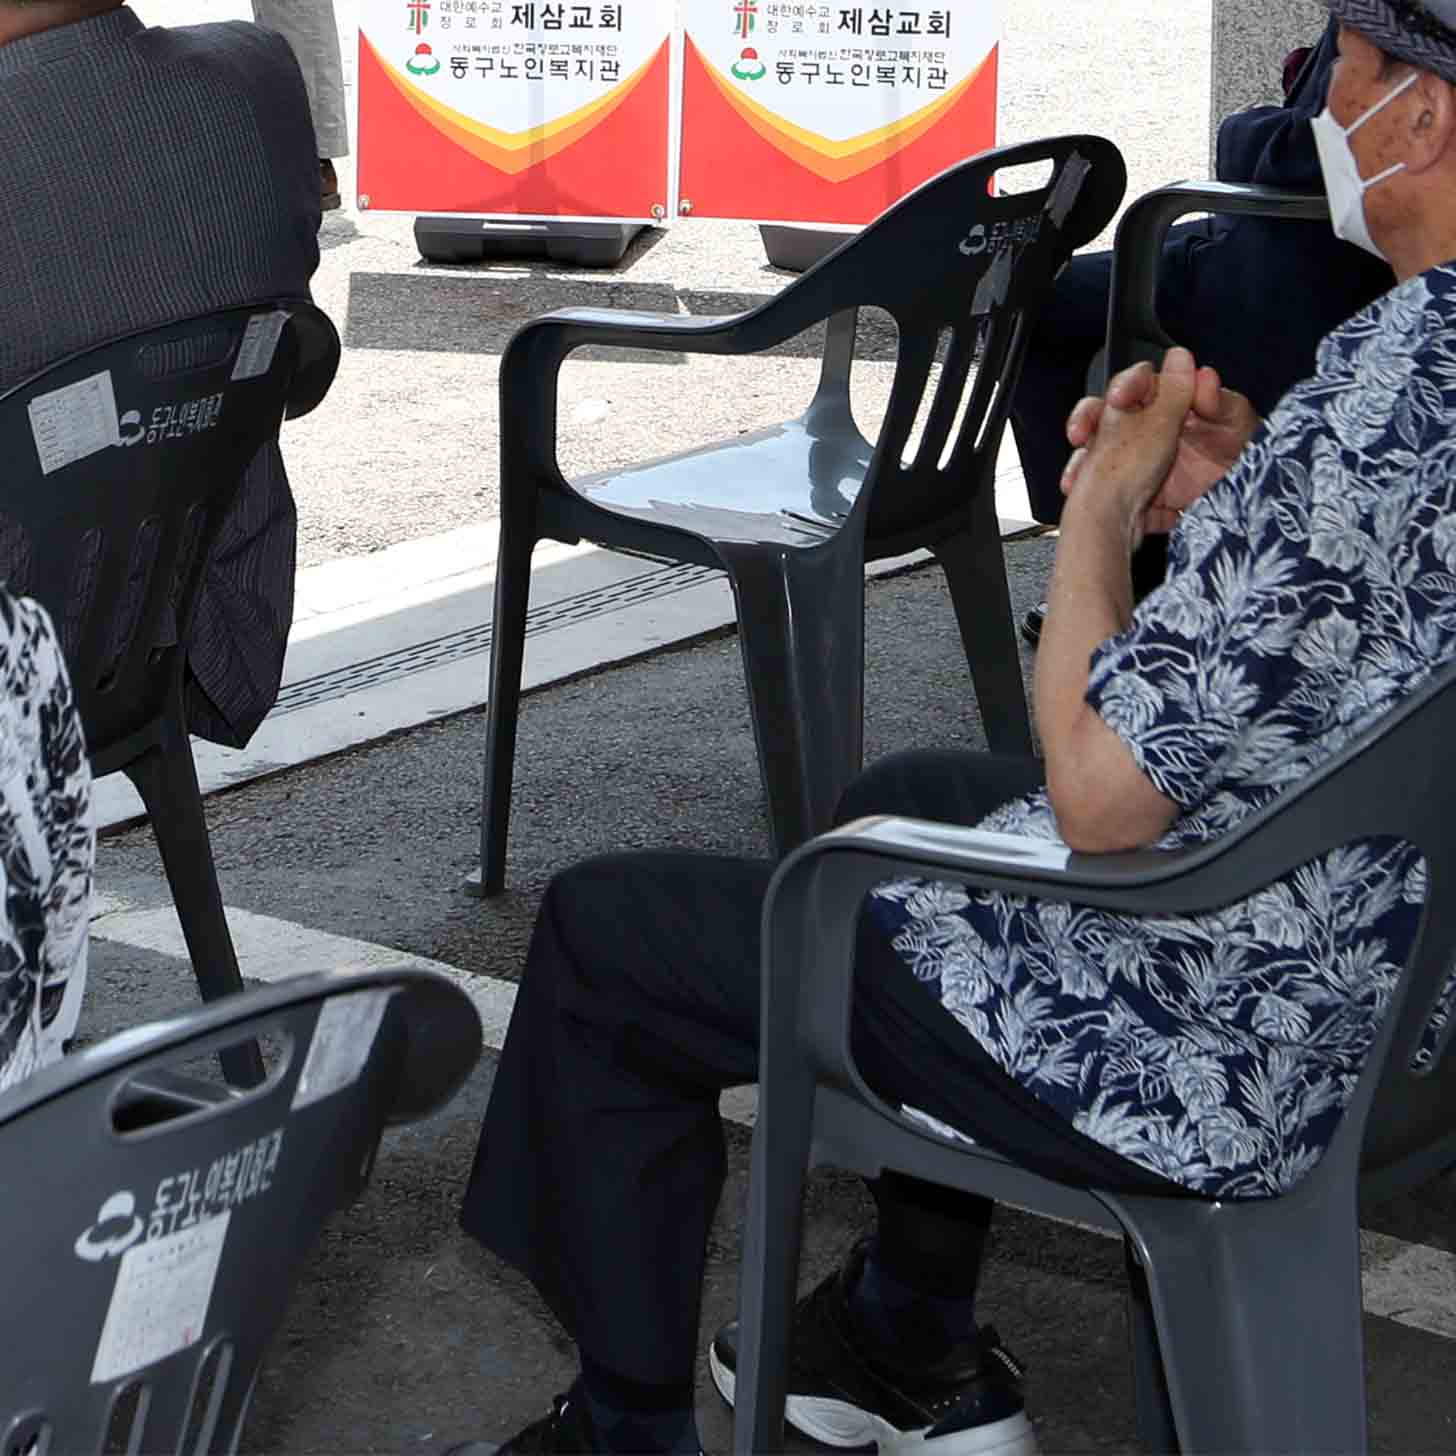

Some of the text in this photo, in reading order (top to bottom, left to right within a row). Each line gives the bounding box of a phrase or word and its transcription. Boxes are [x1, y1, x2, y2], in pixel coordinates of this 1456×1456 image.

[439, 0, 502, 14] 대한예수교
[510, 2, 623, 32] 제삼교회
[767, 4, 831, 18] 대한예수교
[837, 7, 952, 38] 제삼교회
[450, 57, 622, 82] 동구노인복지관
[775, 61, 949, 90] 동구노인복지관
